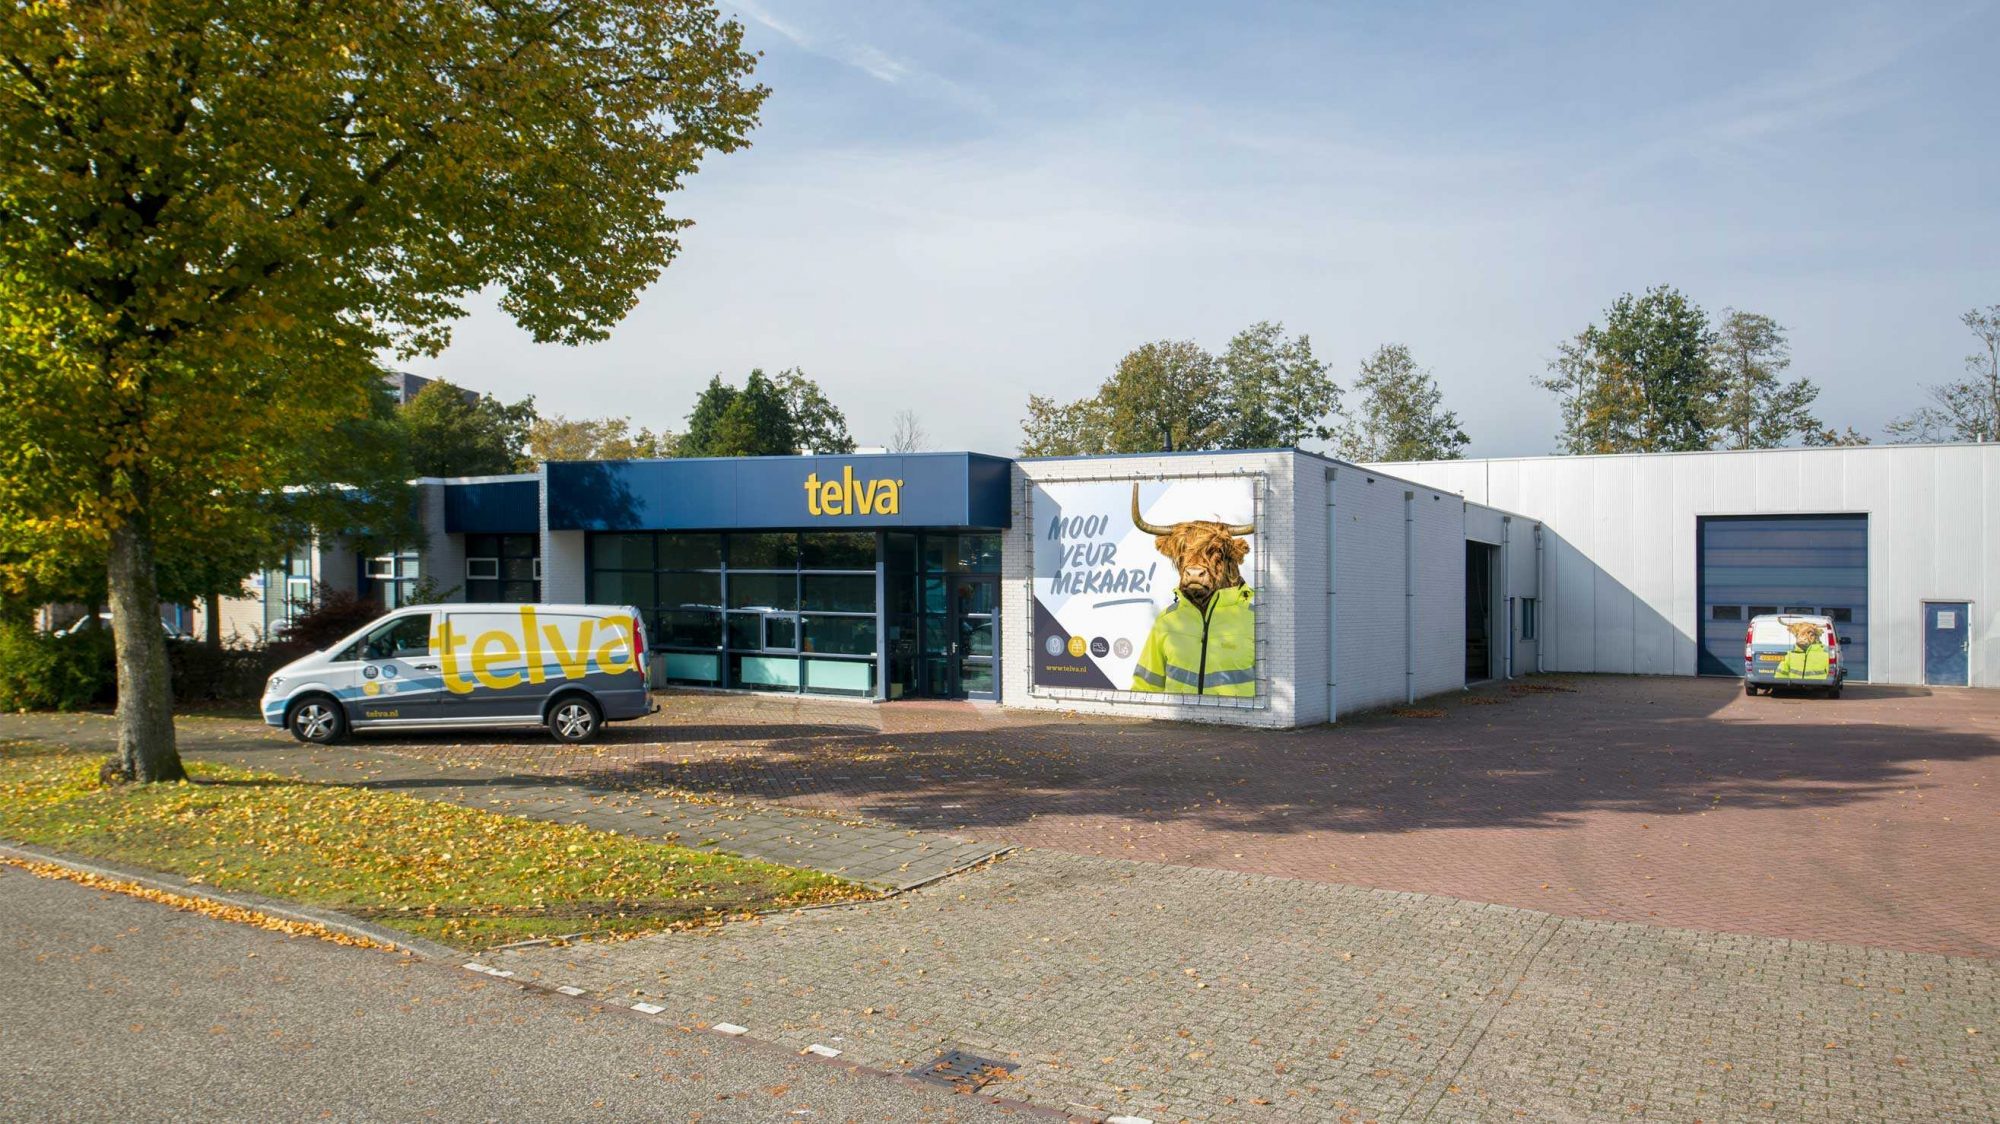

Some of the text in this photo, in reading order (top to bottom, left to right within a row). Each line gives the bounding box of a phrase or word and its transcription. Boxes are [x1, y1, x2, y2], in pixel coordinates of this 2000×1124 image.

[804, 465, 902, 516] telva
[1047, 514, 1108, 540] MOOI
[1060, 542, 1117, 569] VEUR
[1050, 562, 1157, 595] MEKAAR!
[429, 605, 638, 694] telva
